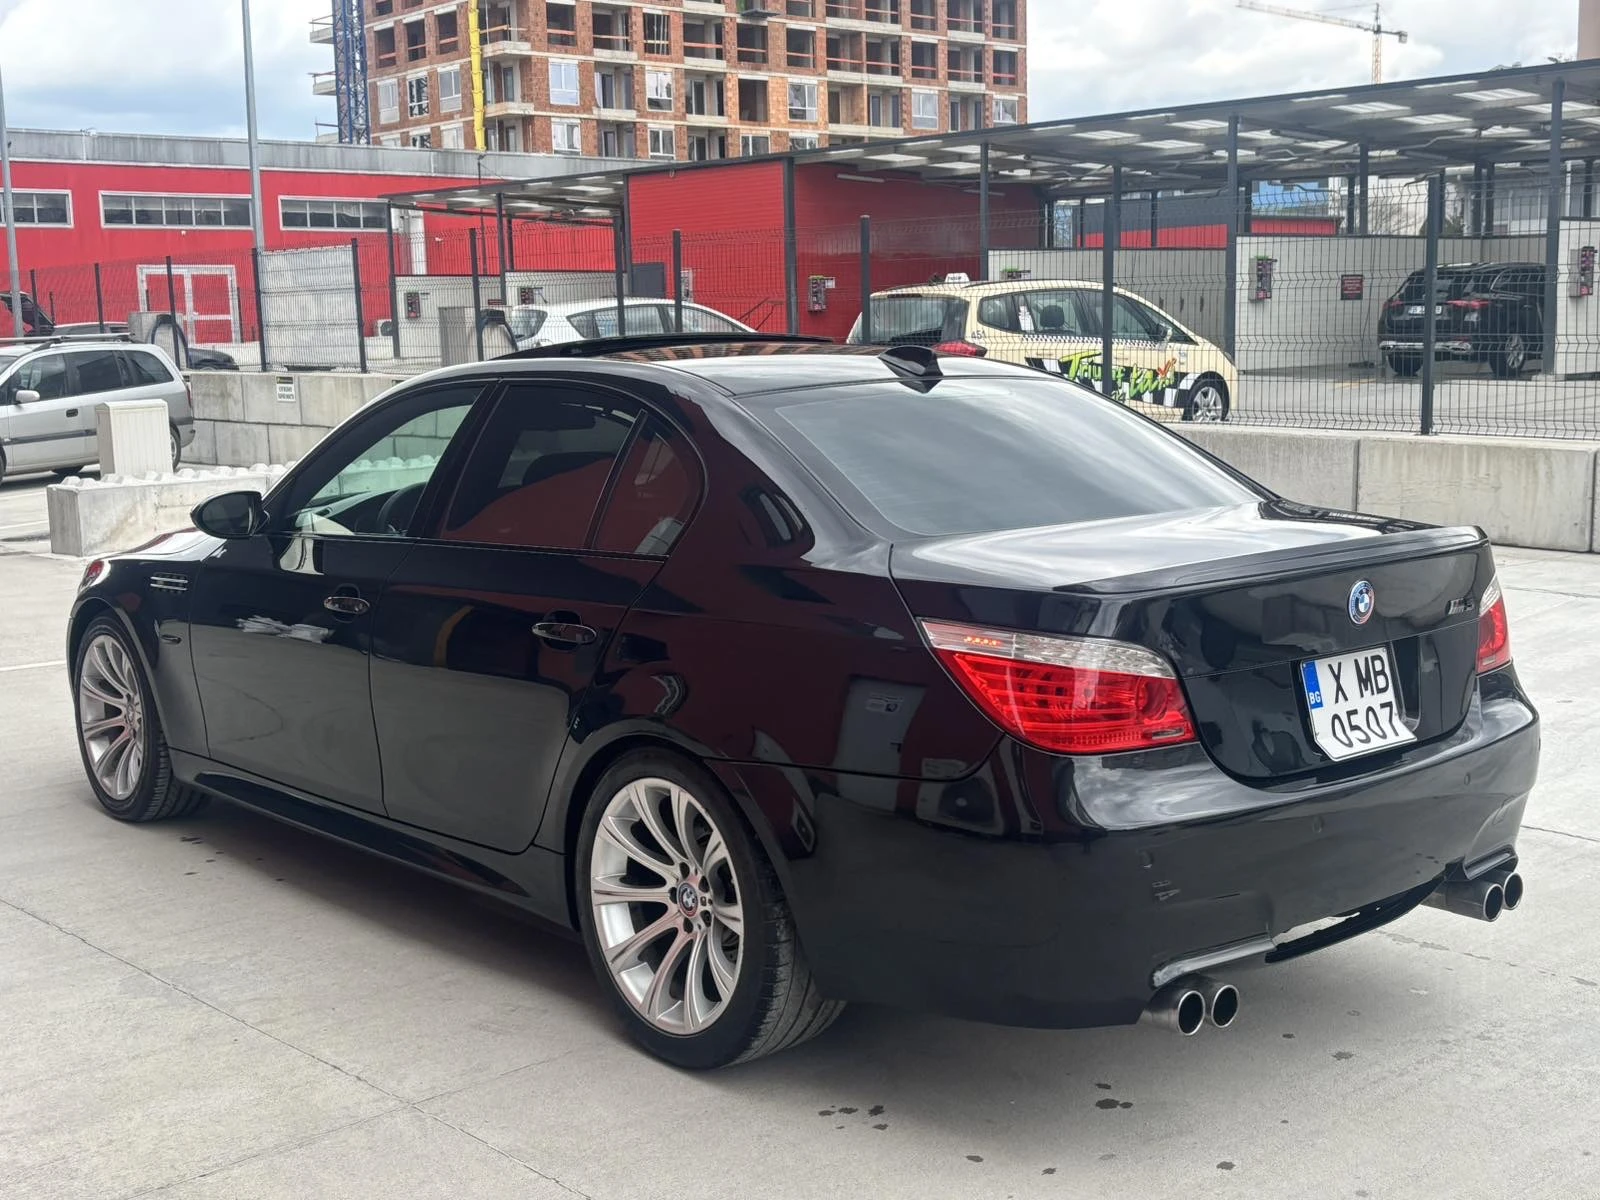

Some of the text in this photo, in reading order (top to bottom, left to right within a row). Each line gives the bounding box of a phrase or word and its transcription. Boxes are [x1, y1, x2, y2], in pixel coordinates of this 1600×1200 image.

[970, 329, 987, 339] 451
[1328, 654, 1390, 704] X MB
[1308, 691, 1321, 705] BG
[1331, 701, 1399, 748] 0507
